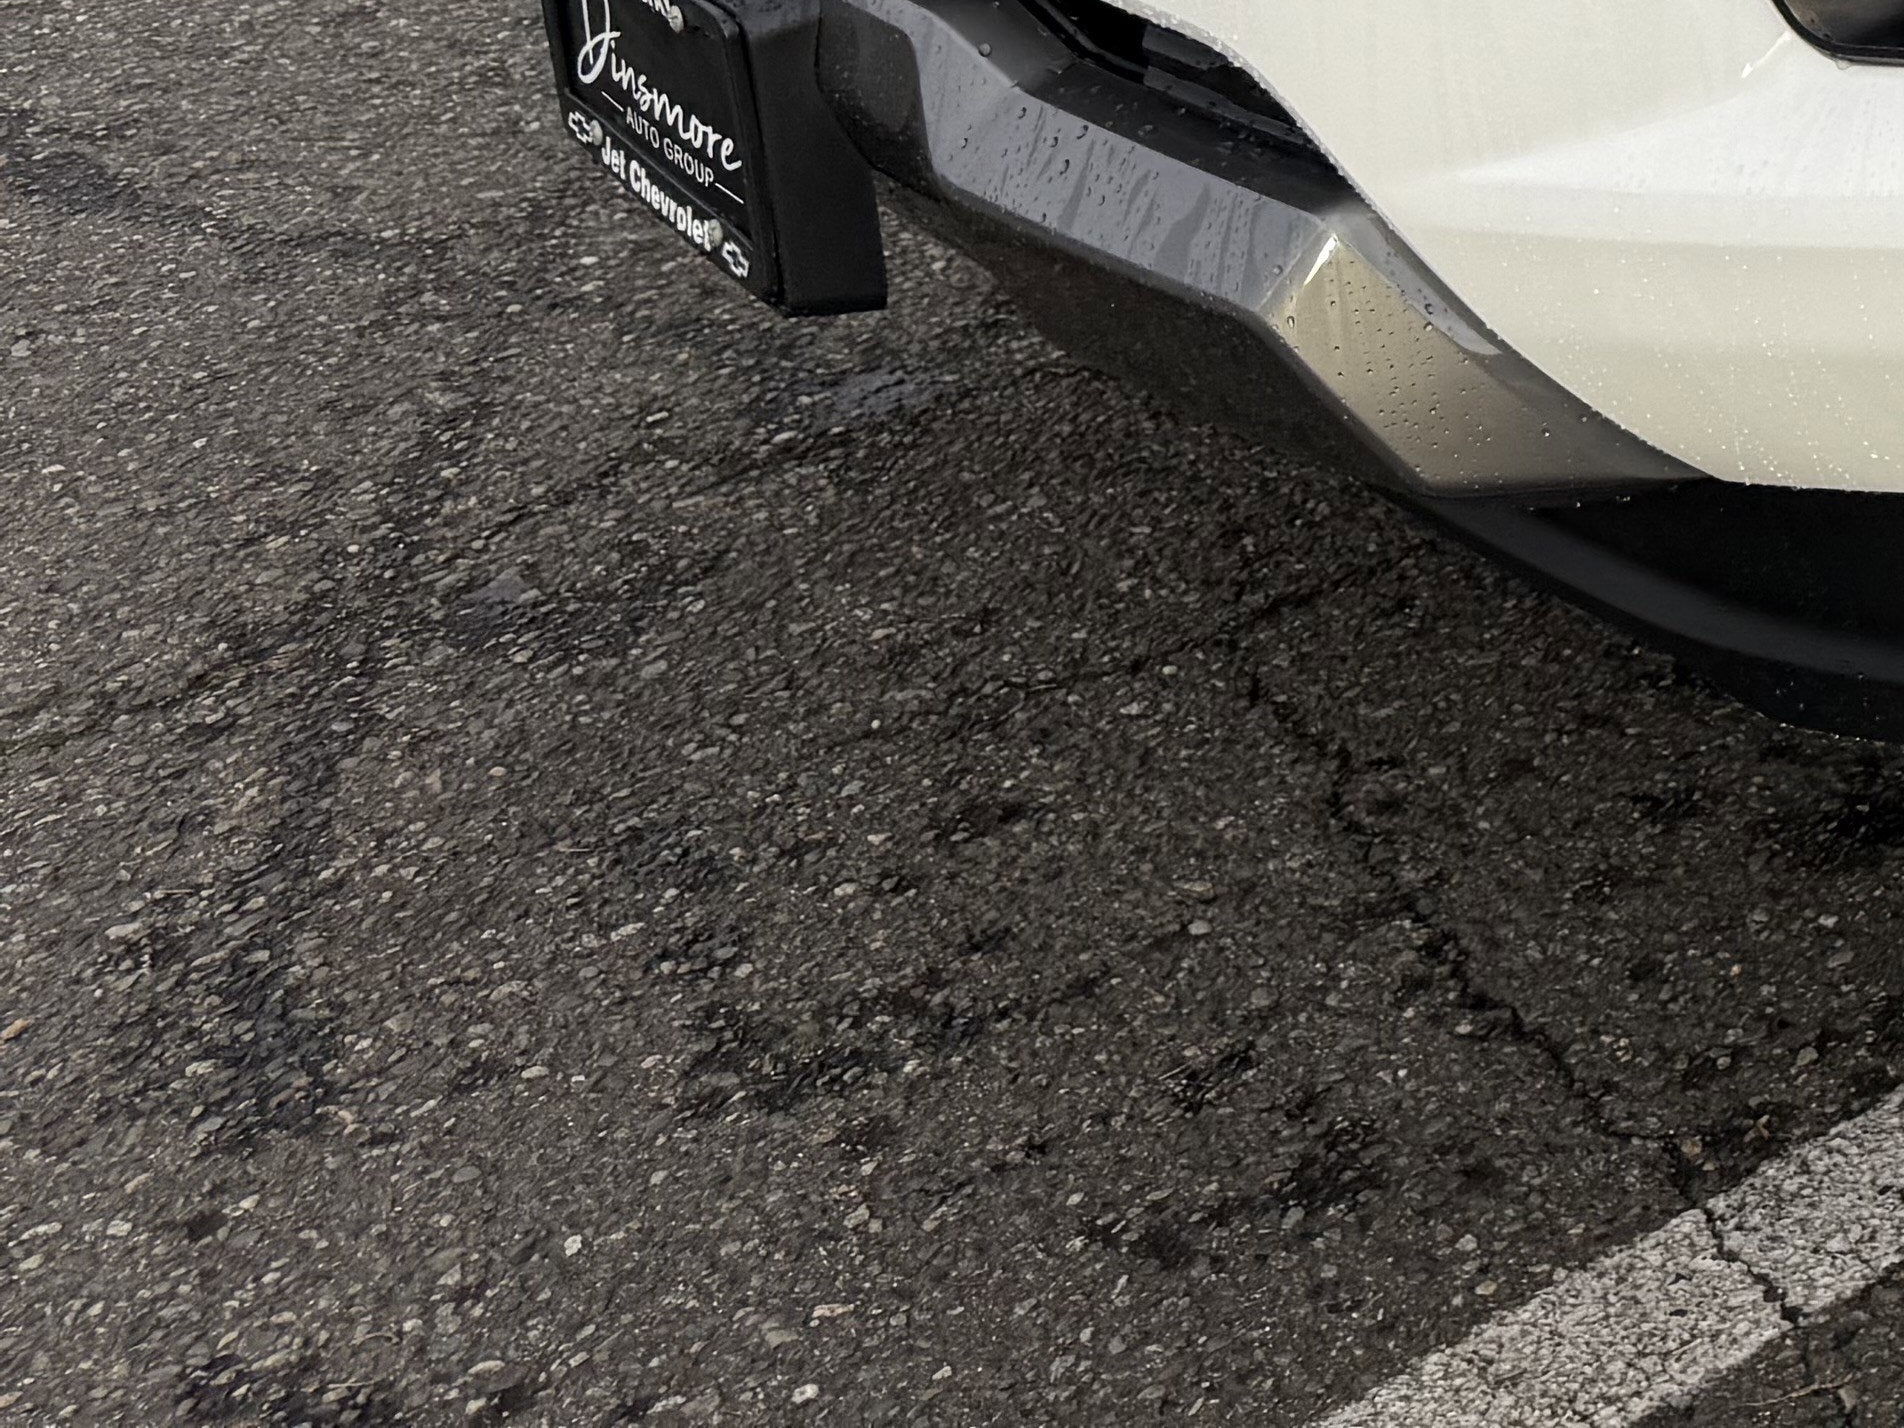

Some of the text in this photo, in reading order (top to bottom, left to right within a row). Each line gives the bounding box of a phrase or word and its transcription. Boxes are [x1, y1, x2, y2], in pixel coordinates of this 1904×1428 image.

[601, 136, 712, 252] Jet Chevrolet
[626, 106, 714, 188] AUTO GROUP
